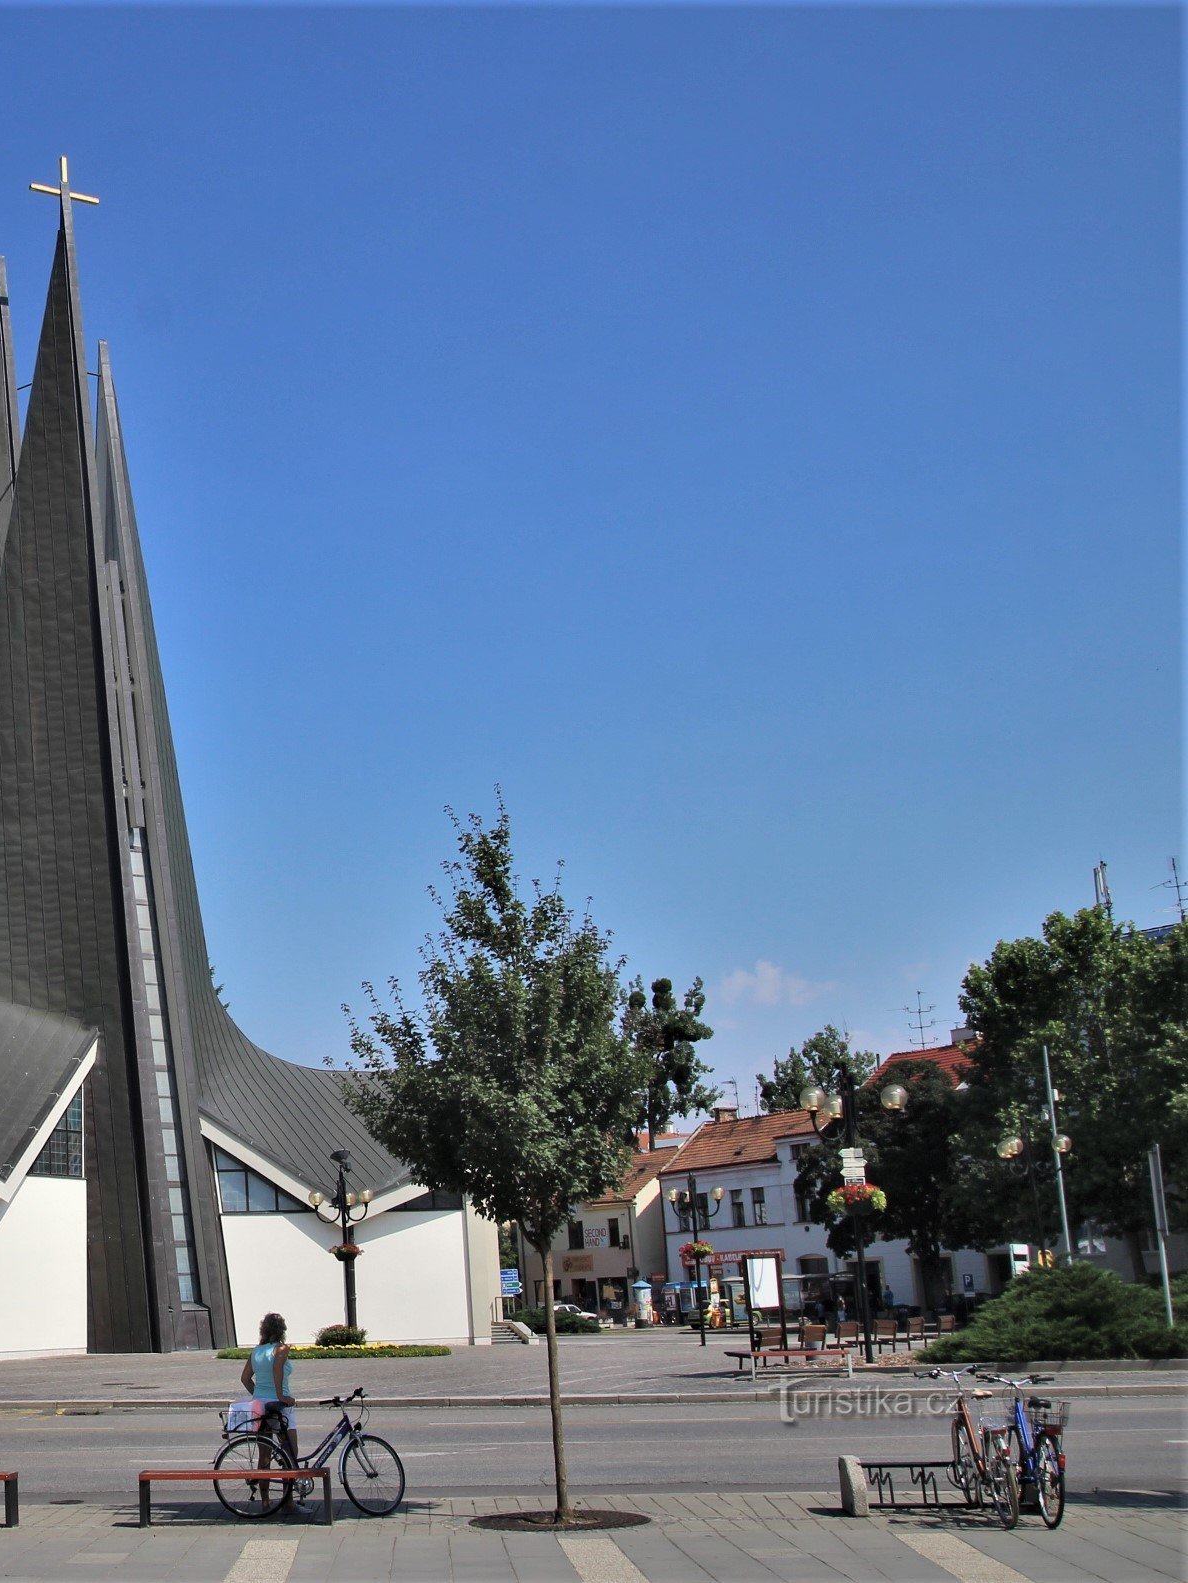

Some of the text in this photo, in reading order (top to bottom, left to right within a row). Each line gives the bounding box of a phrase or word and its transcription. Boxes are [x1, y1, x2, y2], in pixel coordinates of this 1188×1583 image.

[584, 1228, 607, 1238] SECOND
[584, 1238, 600, 1247] HAND
[964, 1275, 970, 1286] P
